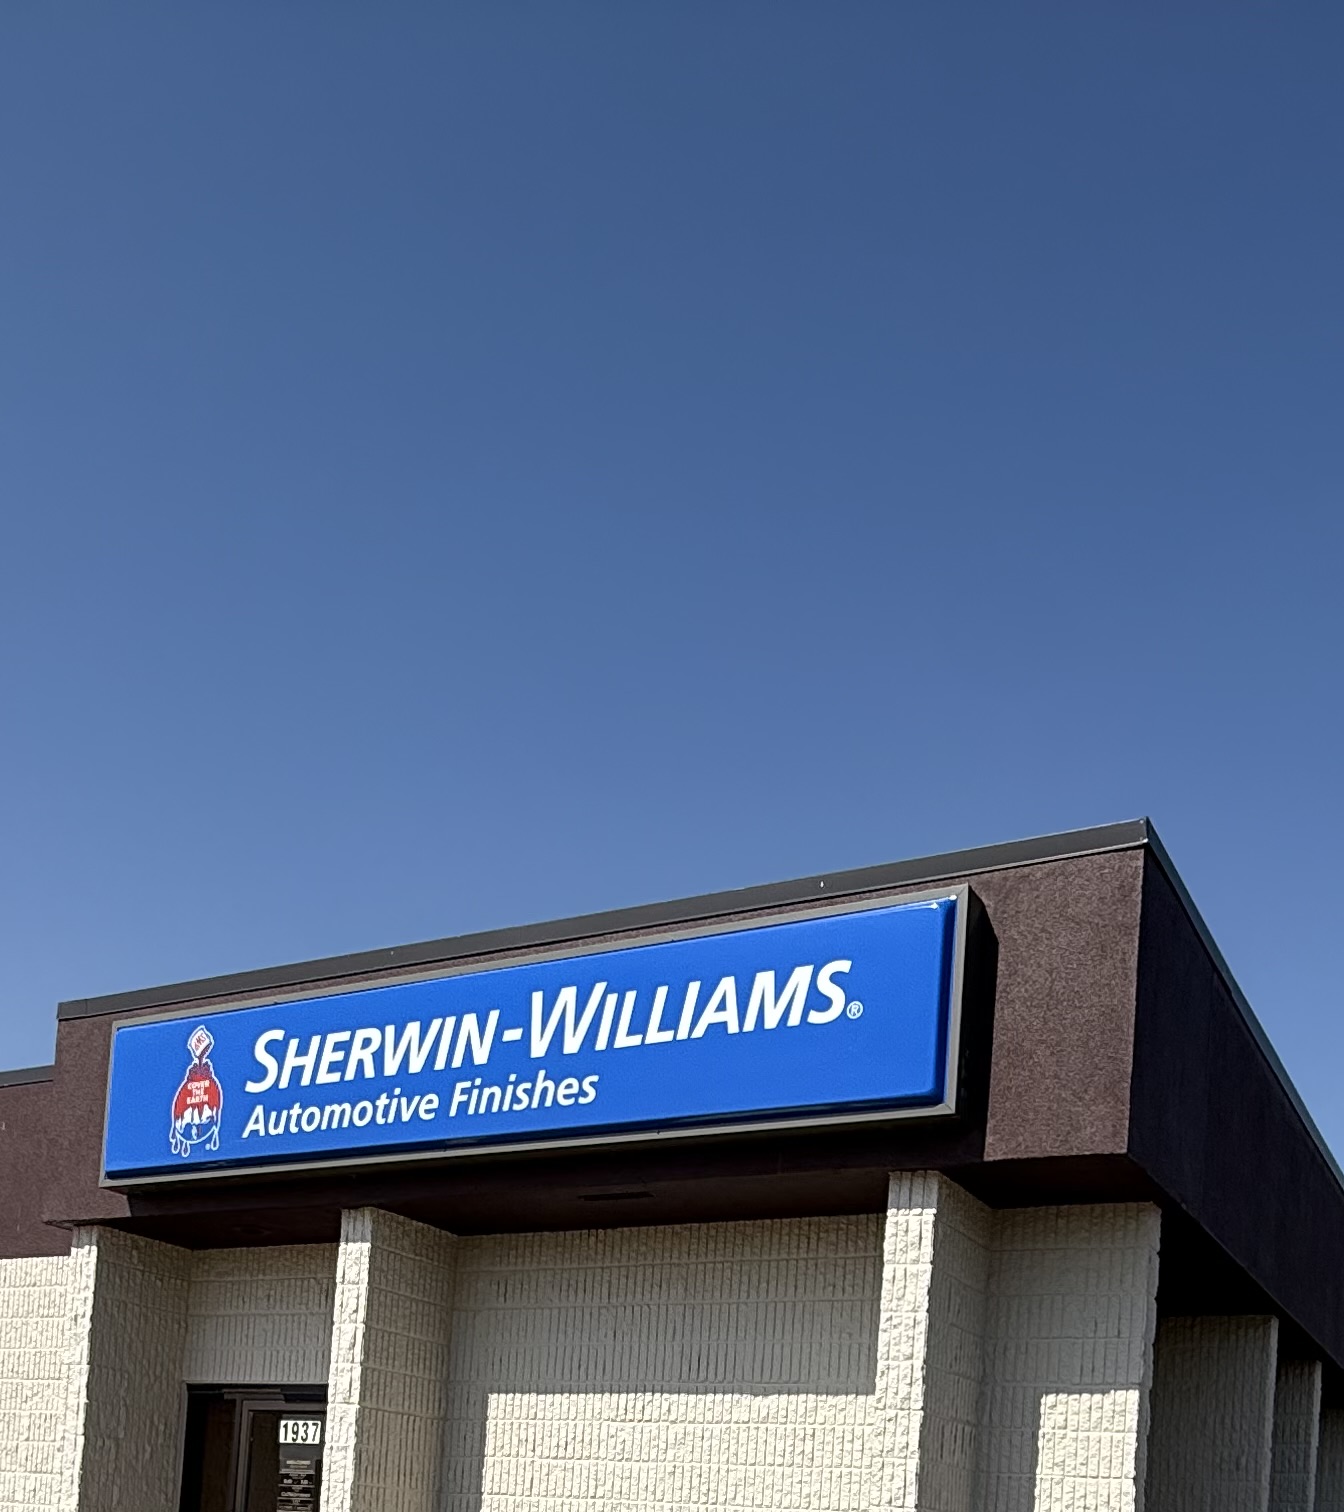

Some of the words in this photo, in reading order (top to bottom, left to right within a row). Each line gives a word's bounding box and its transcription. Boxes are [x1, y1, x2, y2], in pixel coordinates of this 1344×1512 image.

[187, 1080, 210, 1090] COVER
[187, 1095, 209, 1105] EARTH
[241, 1087, 439, 1139] Automotive
[449, 1069, 600, 1118] Finishes
[282, 1421, 319, 1443] 1937
